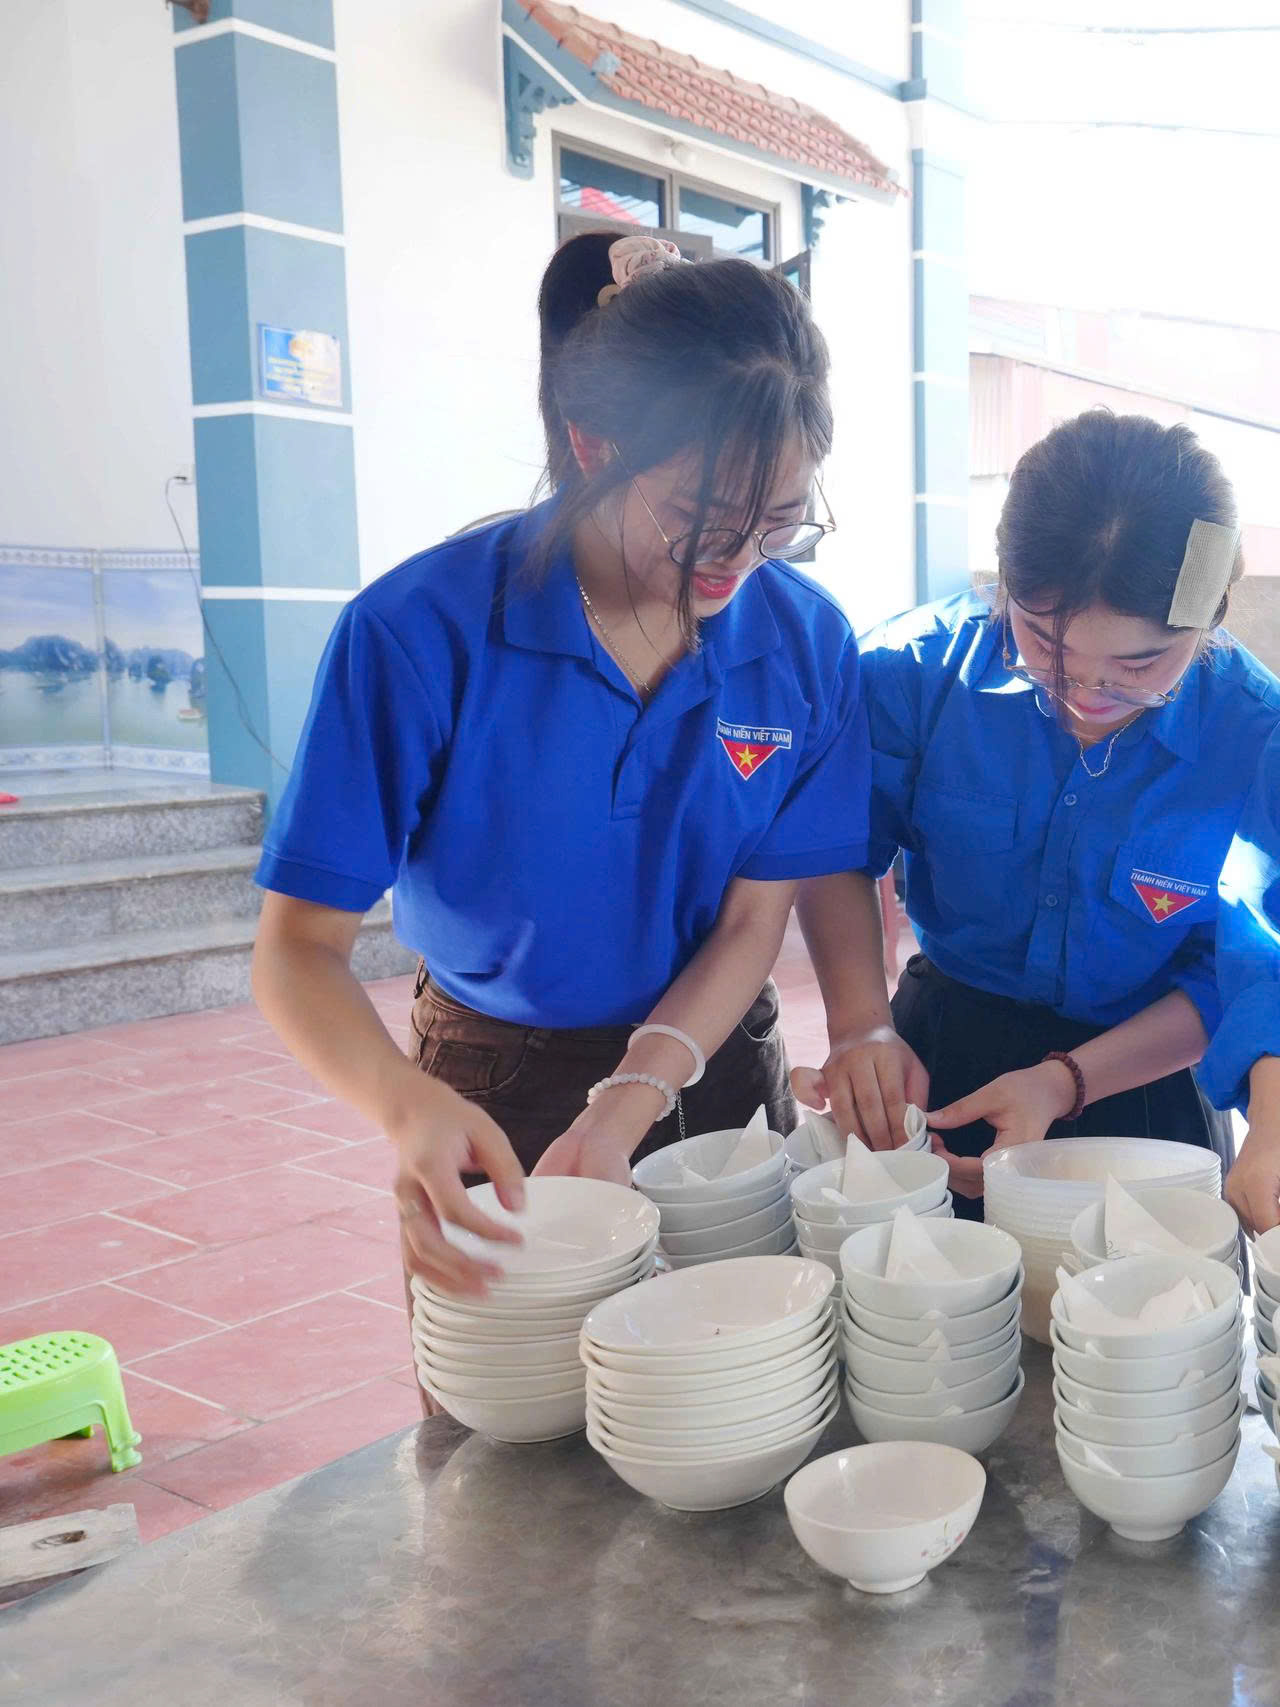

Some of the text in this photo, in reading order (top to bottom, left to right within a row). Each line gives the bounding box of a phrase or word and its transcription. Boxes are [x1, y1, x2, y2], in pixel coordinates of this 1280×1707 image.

[772, 732, 790, 744] NAM
[1130, 872, 1155, 885] THANH
[1191, 887, 1208, 897] NAM
